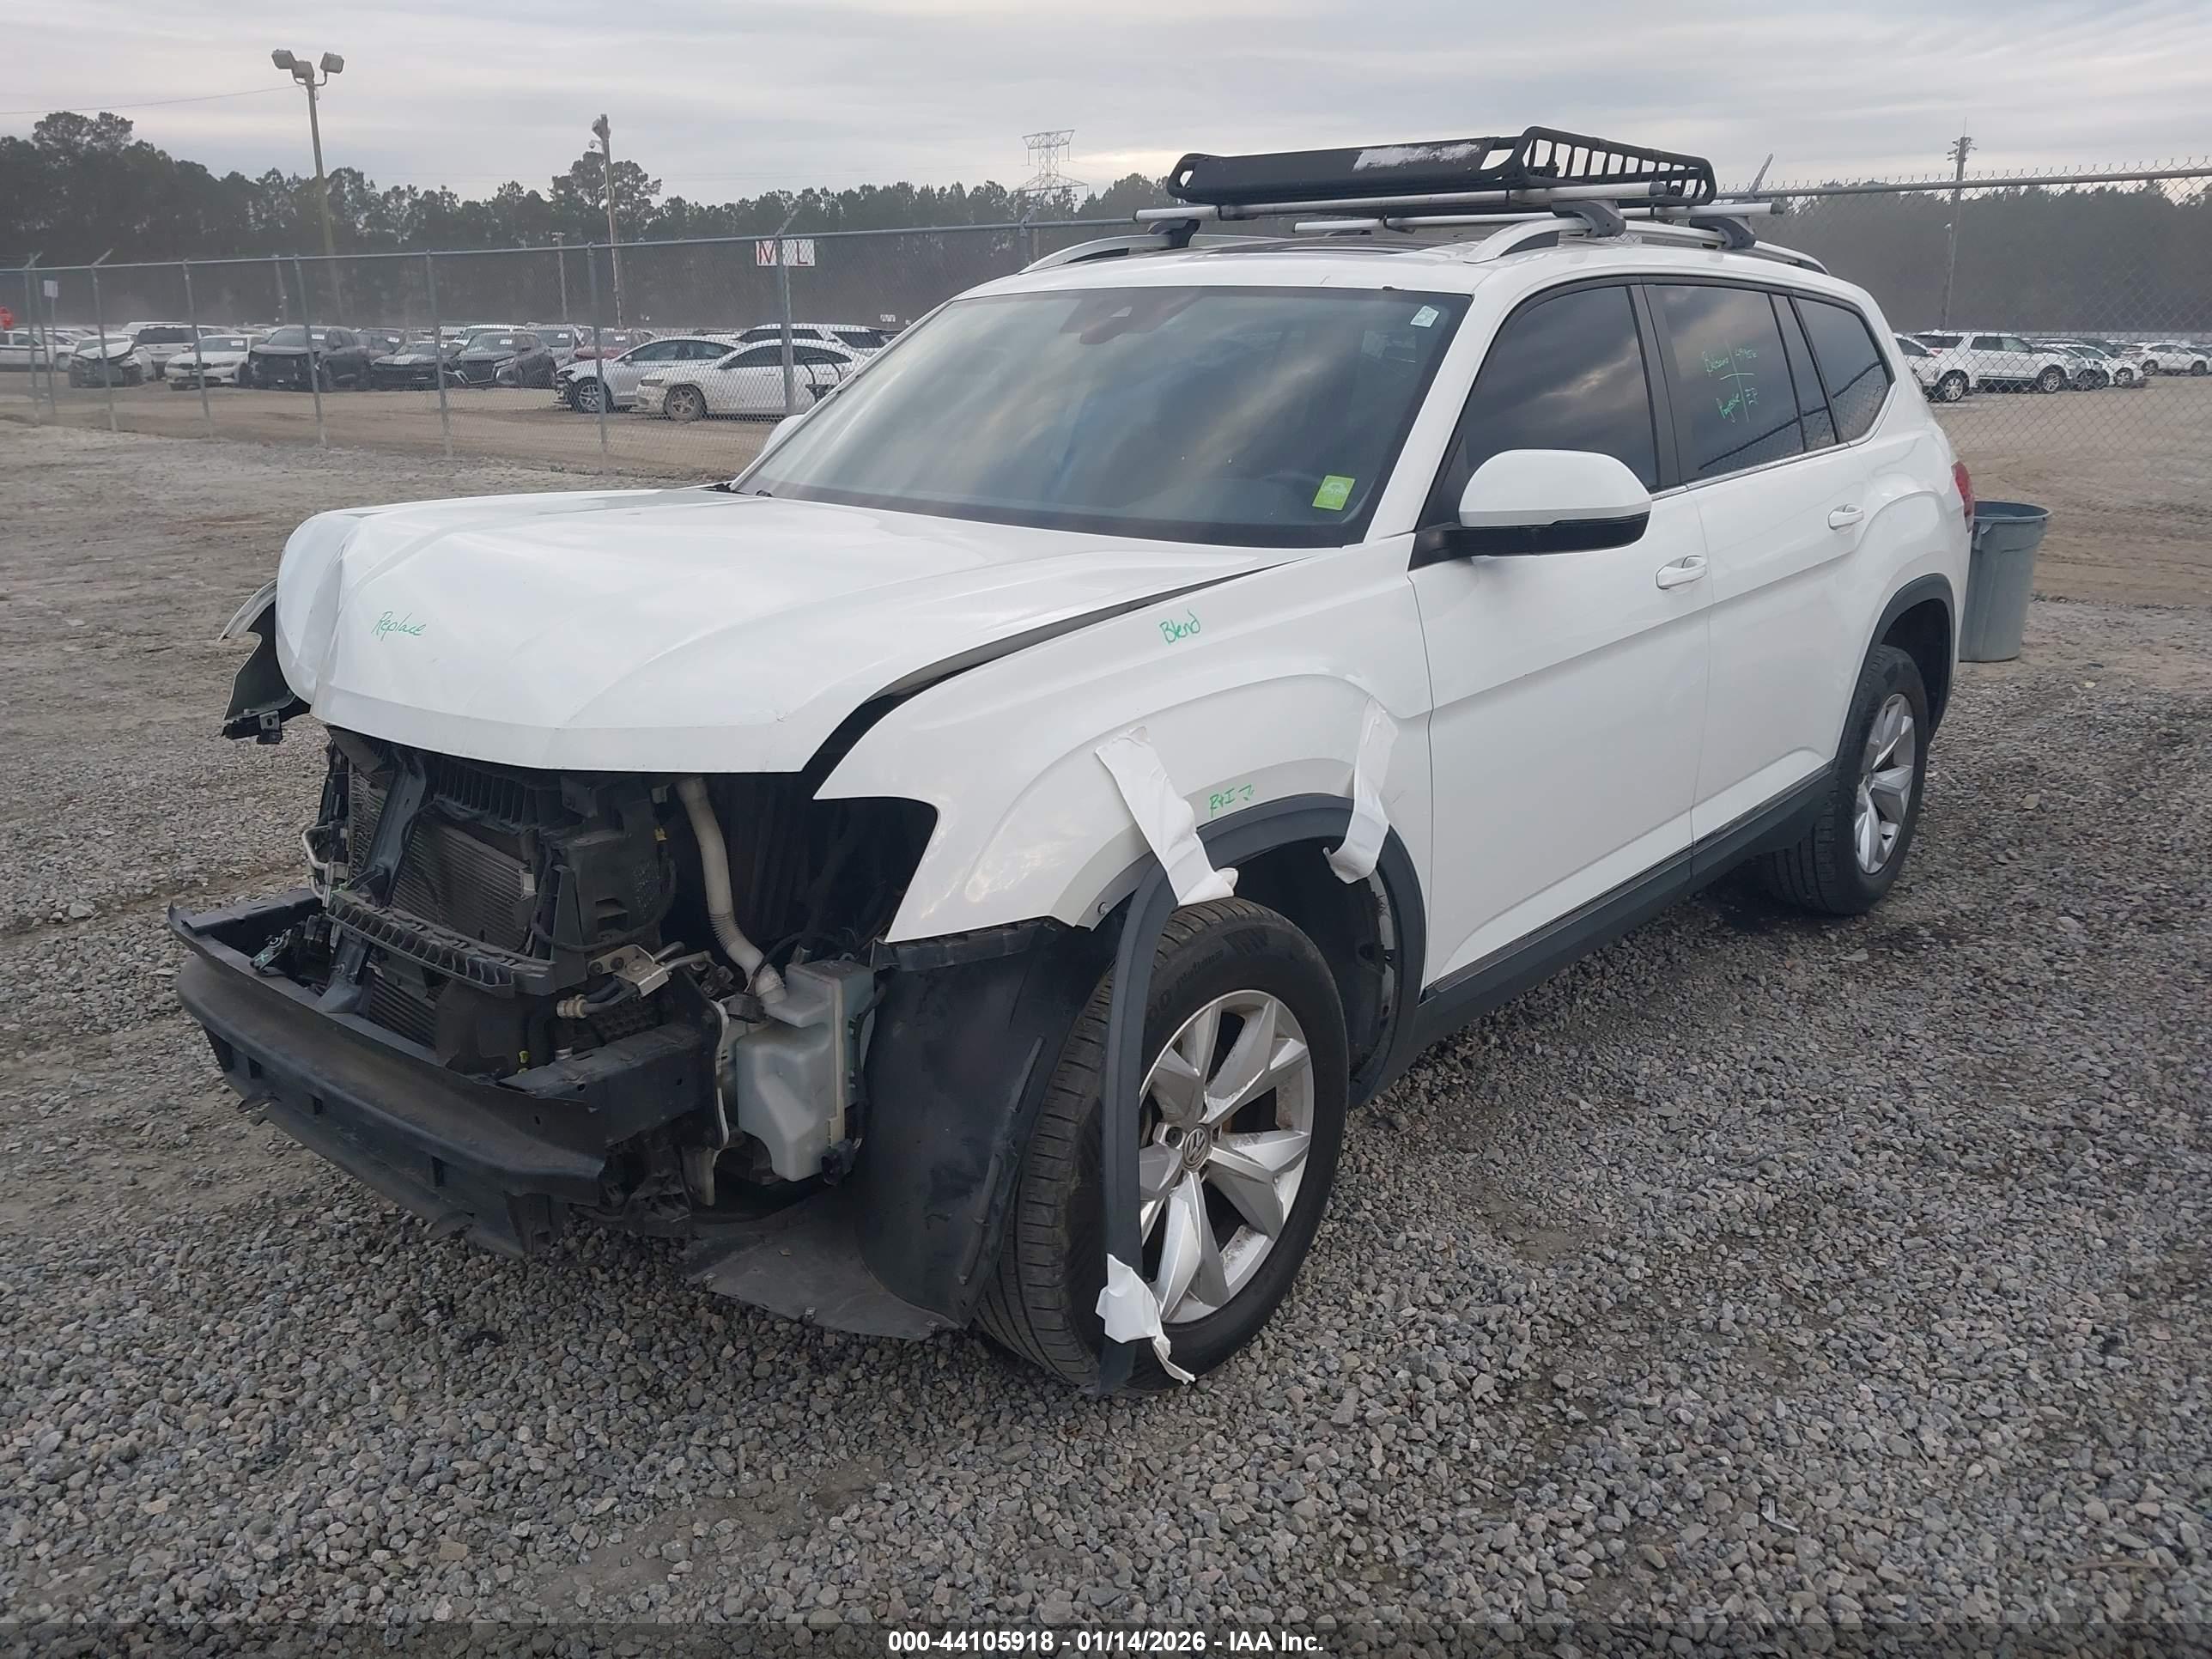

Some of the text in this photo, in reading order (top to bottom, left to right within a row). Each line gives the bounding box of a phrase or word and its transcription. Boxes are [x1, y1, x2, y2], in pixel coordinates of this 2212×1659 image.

[796, 240, 808, 264] L
[370, 611, 426, 641] Replace
[1159, 609, 1200, 644] Blend
